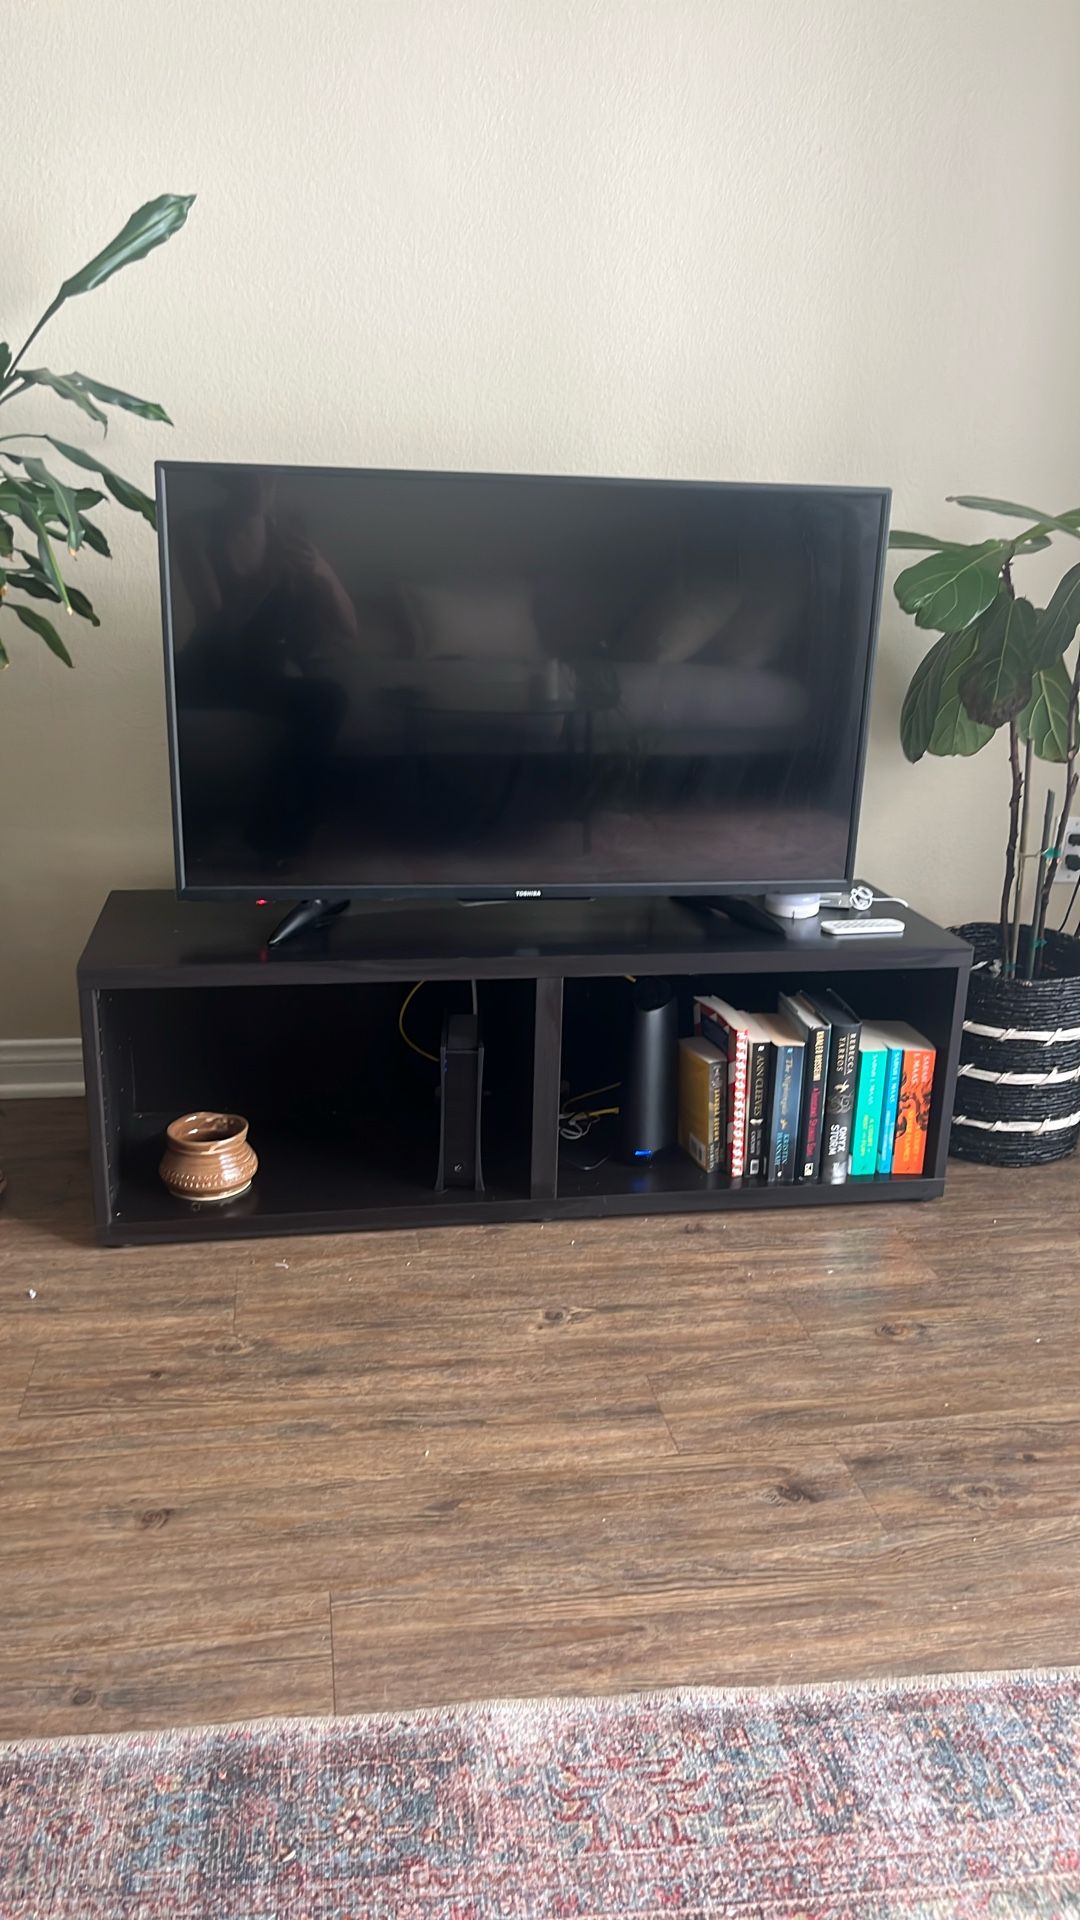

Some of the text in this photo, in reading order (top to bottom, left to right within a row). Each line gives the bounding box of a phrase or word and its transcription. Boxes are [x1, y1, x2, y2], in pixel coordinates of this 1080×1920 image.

[515, 889, 542, 898] TOSHIBA
[815, 1031, 825, 1054] KHALED
[837, 1037, 846, 1072] YARROS
[846, 1032, 857, 1075] REBECCA
[911, 1061, 920, 1084] MAAS
[920, 1055, 930, 1083] SARAH
[754, 1055, 764, 1116] ANN CLEEVES
[829, 1124, 839, 1156] STORM
[837, 1126, 848, 1152] ONYX
